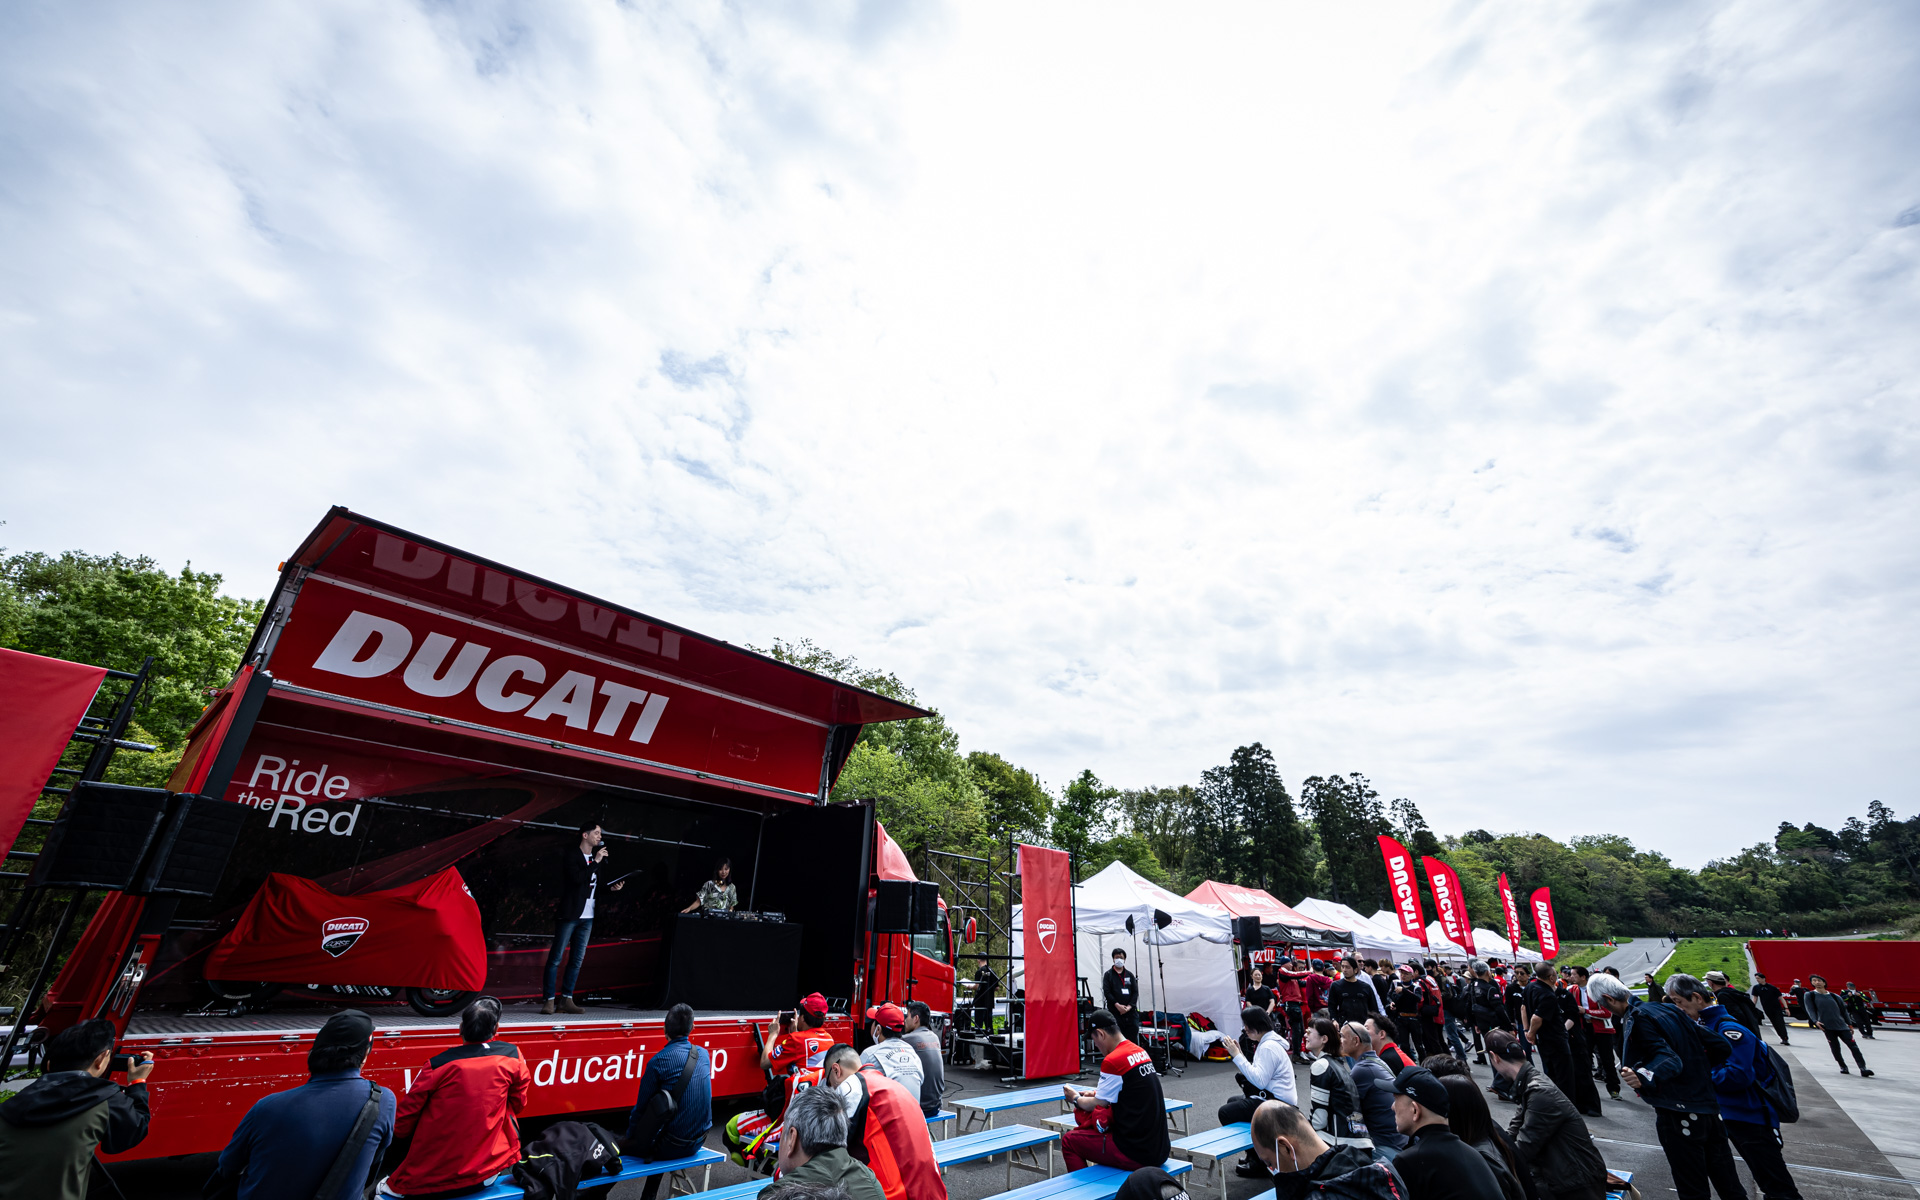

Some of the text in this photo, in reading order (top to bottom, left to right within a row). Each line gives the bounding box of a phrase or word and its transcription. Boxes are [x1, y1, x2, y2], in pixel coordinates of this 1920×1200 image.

[312, 610, 669, 744] DUCATI
[248, 754, 350, 799] Ride
[237, 791, 362, 837] the Red
[327, 922, 365, 931] DUCATI
[1535, 900, 1556, 952] DUCATI
